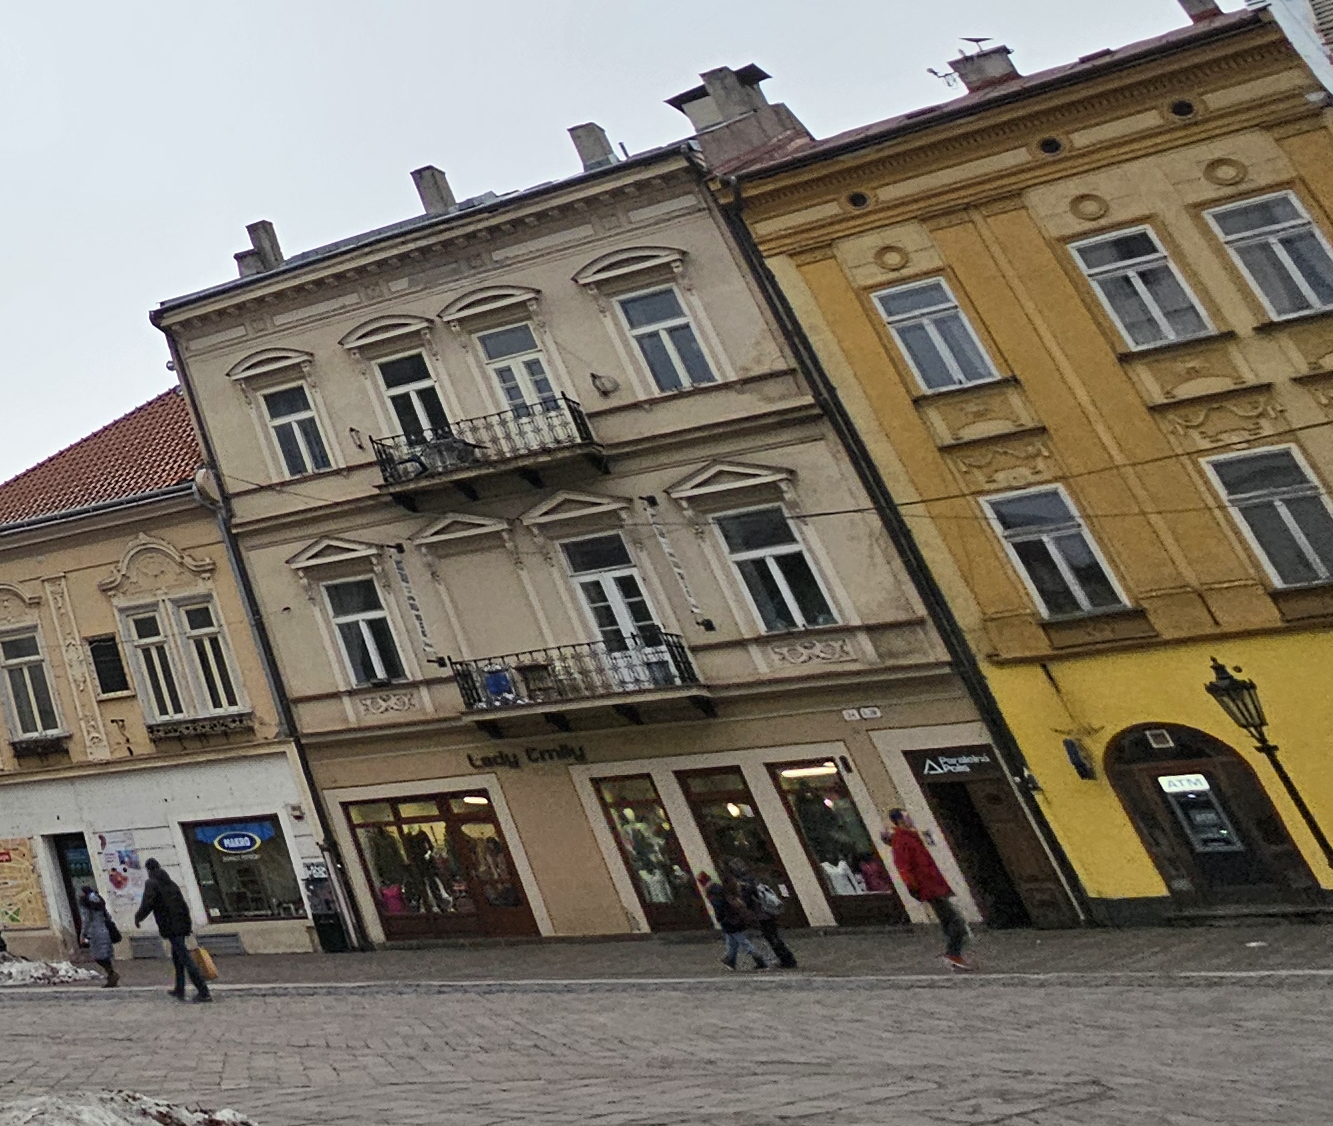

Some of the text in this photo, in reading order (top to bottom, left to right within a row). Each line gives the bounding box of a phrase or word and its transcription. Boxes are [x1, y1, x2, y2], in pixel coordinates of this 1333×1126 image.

[467, 744, 587, 769] Lady Emily
[1168, 778, 1203, 788] ATM
